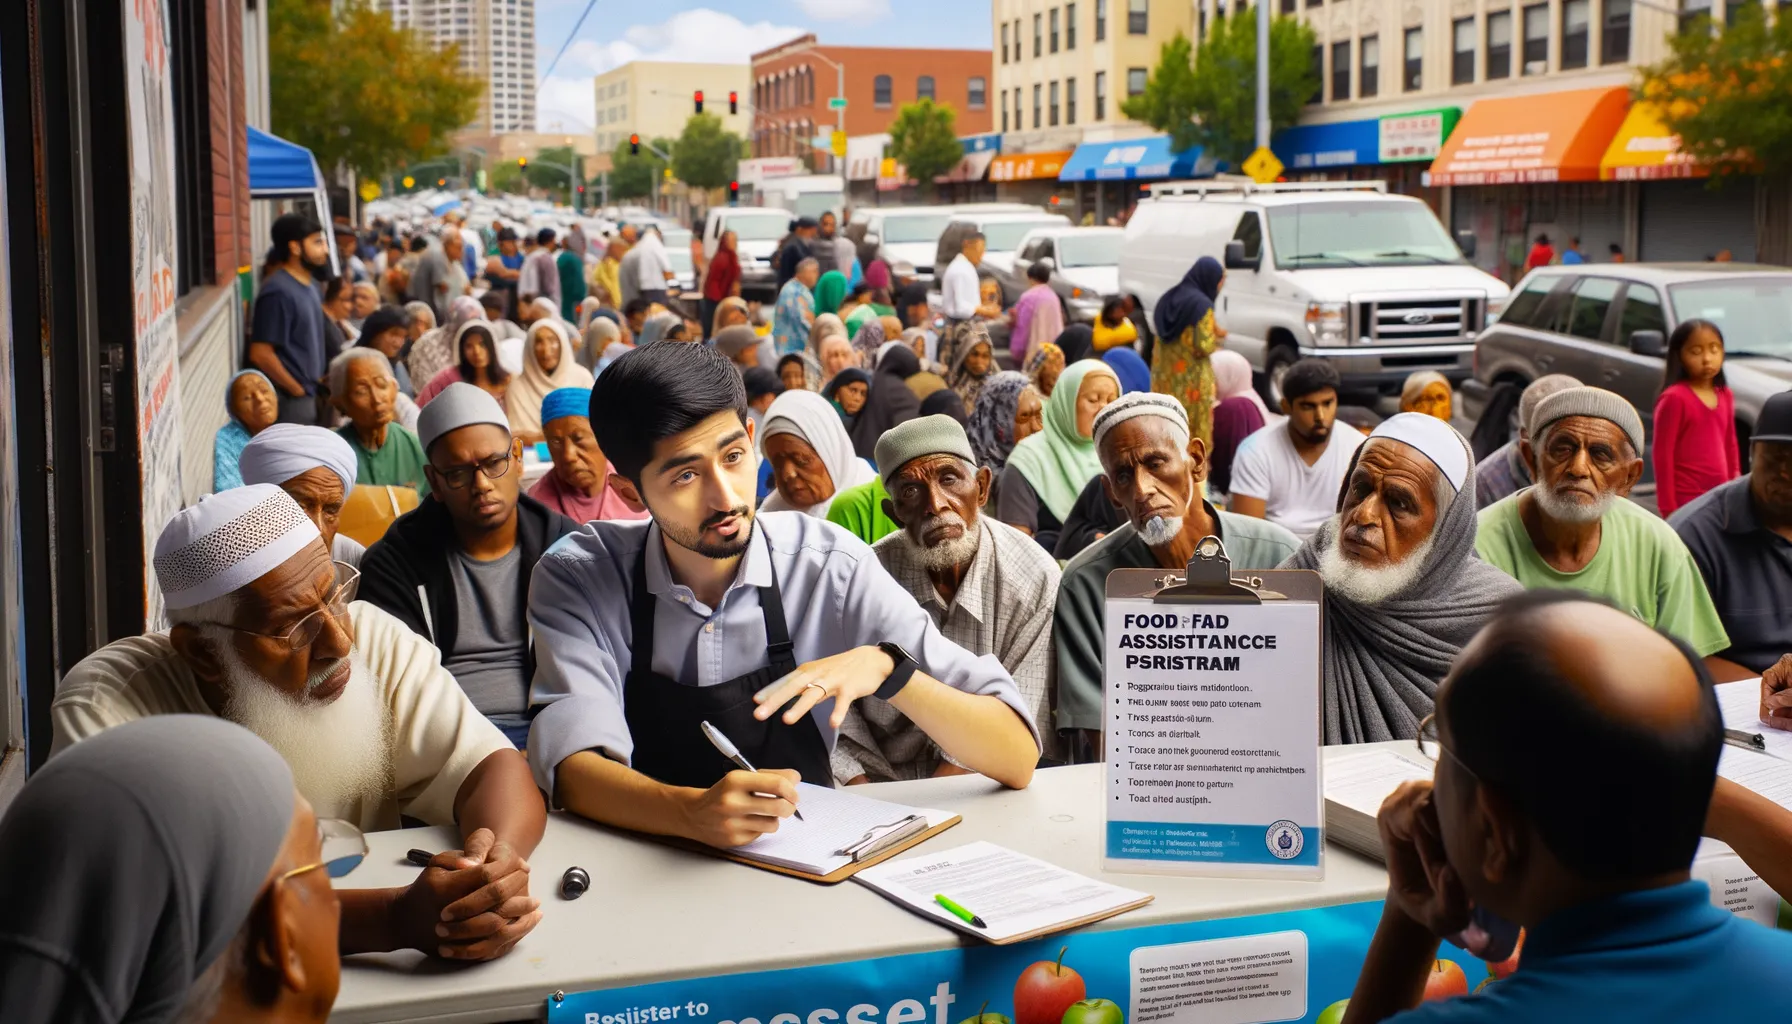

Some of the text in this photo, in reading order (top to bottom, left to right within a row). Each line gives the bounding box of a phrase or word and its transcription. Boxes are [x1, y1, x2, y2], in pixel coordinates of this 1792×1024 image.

[1124, 614, 1229, 629] FOOD FAD
[684, 1000, 709, 1017] to
